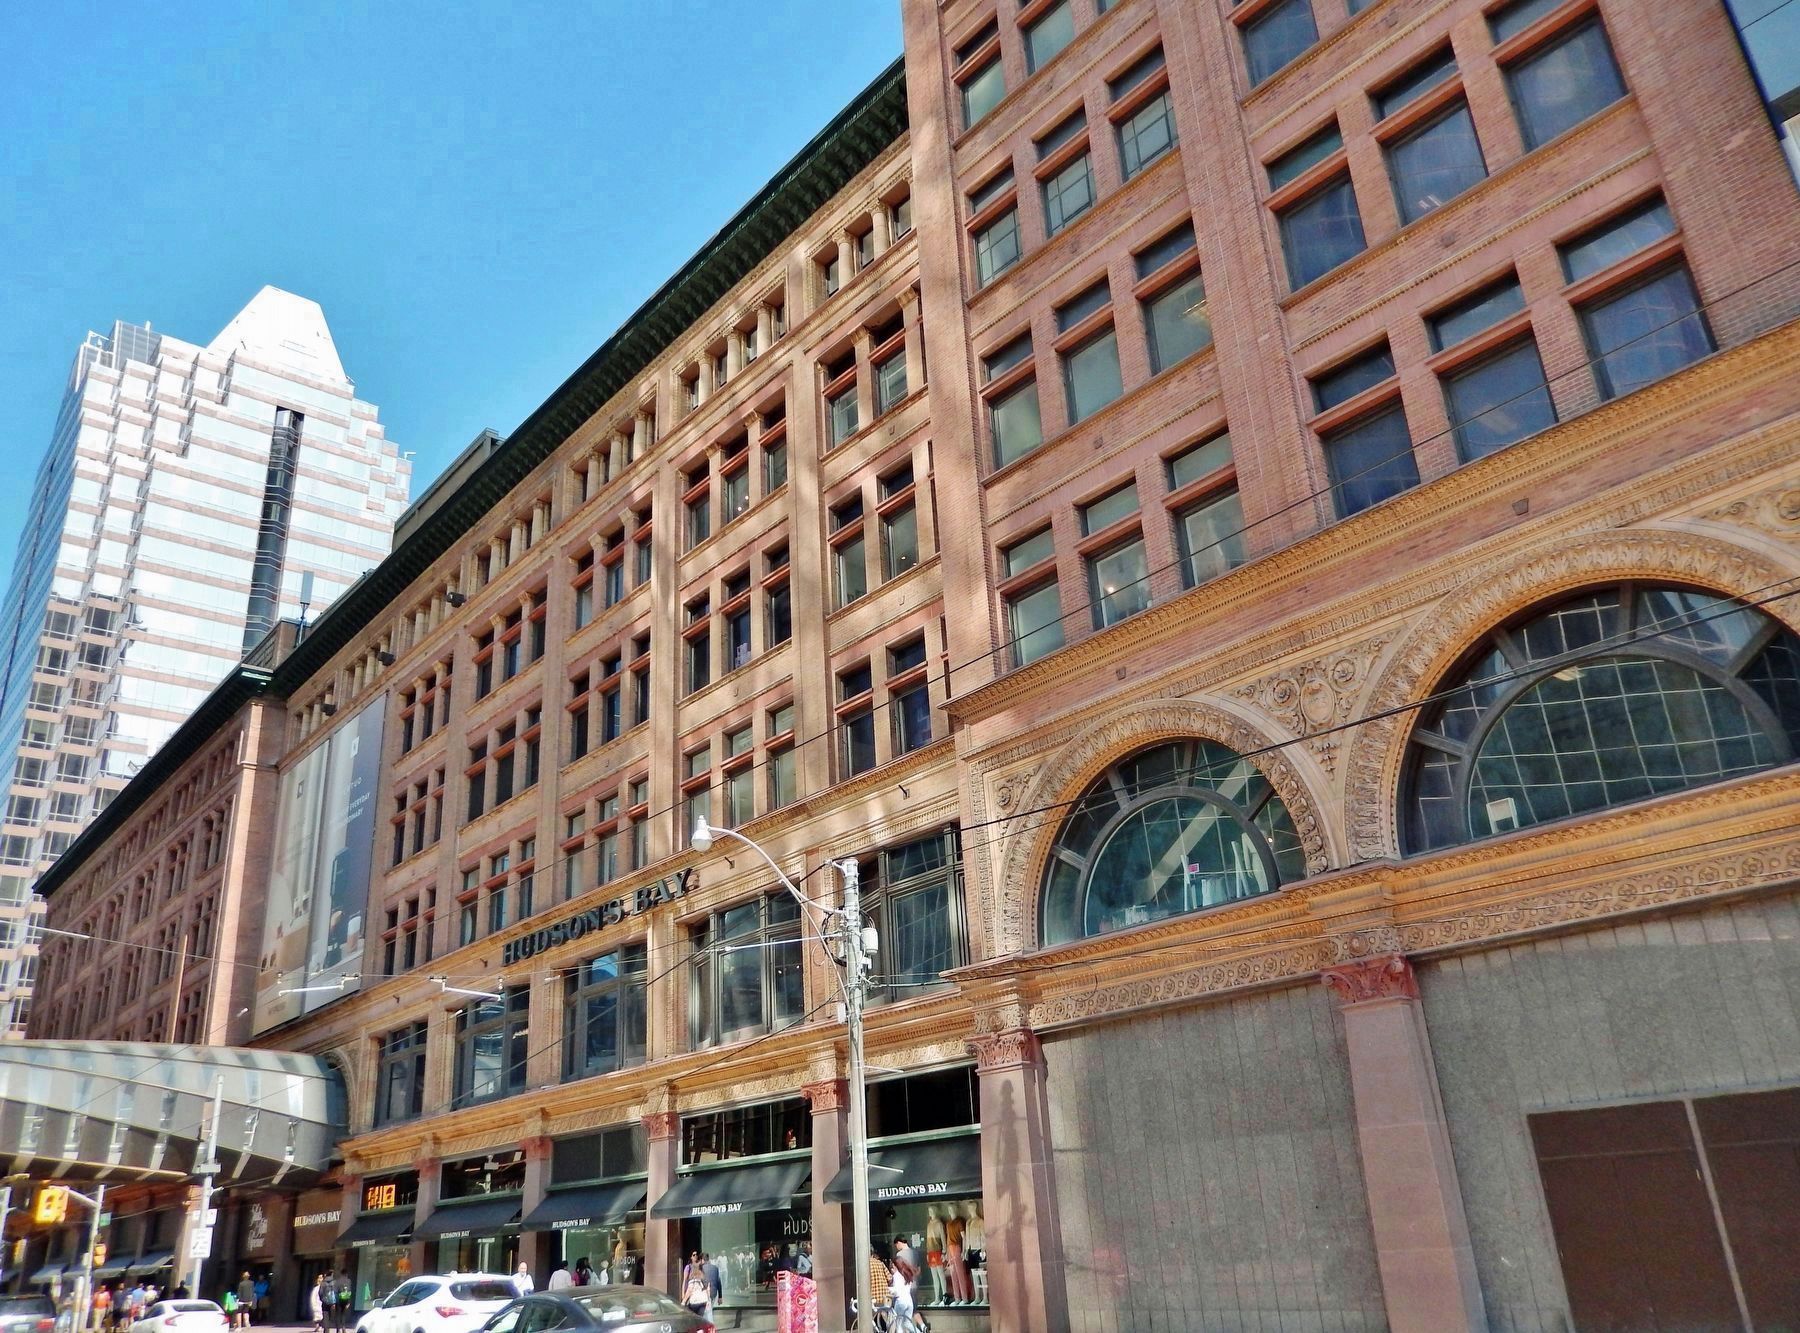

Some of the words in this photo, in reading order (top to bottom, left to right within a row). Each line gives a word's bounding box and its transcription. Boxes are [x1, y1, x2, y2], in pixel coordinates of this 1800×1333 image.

[502, 899, 625, 966] HUDSON'S
[631, 867, 693, 916] BAY
[878, 1184, 926, 1198] HUDSON'S
[927, 1182, 948, 1192] BAY
[691, 1204, 727, 1215] HUDSON'S
[727, 1203, 743, 1212] BAY
[294, 1212, 326, 1227] HUDSON'S
[327, 1210, 342, 1222] BAY
[552, 1219, 578, 1229] HUDSON'S
[579, 1218, 590, 1226] BAY
